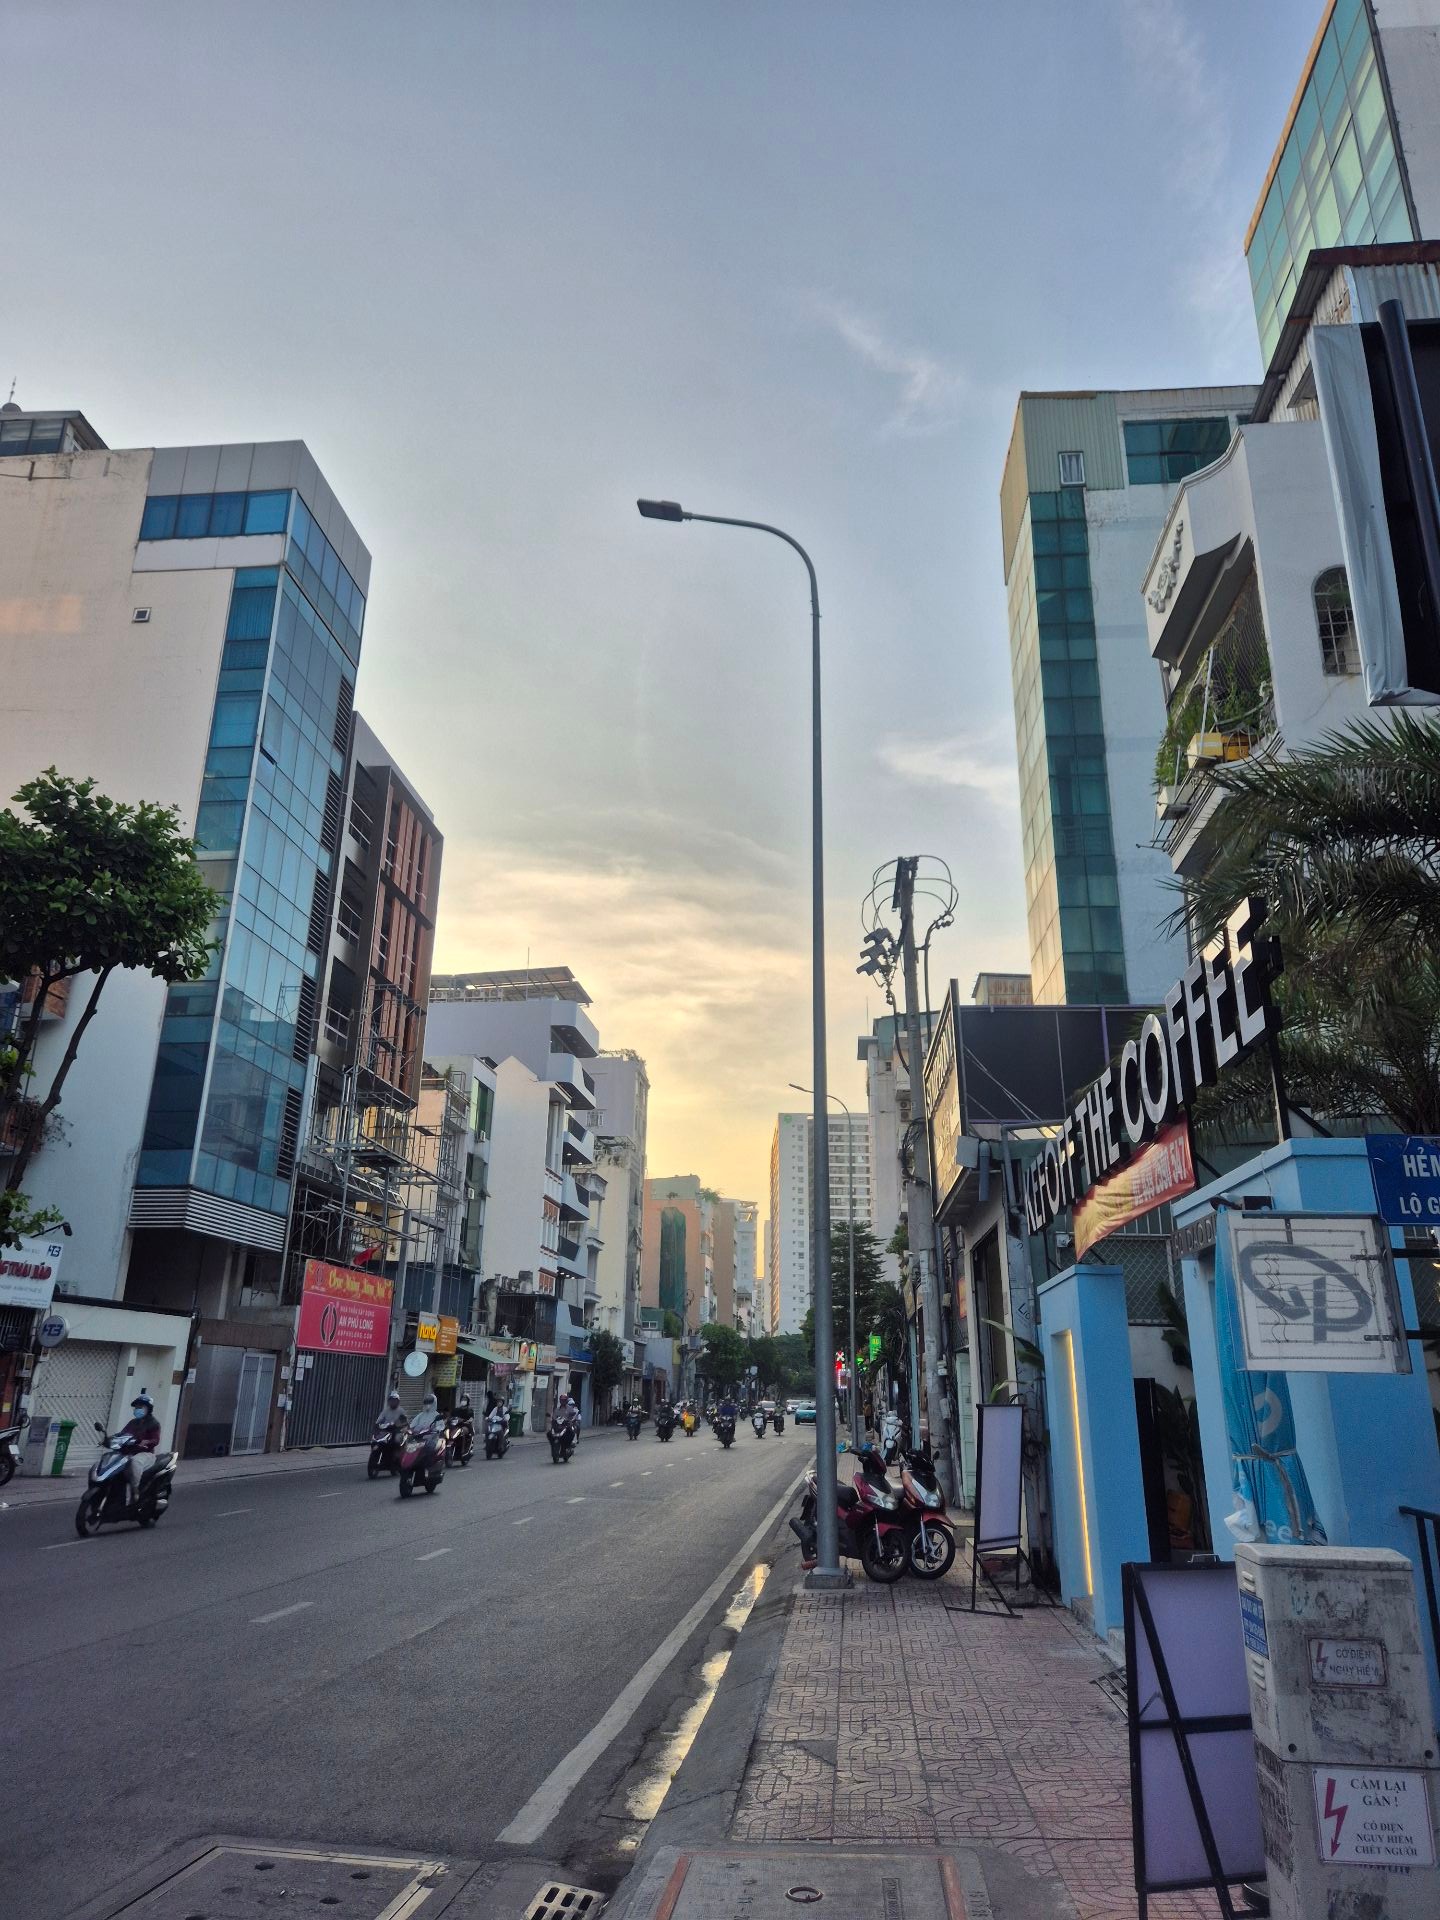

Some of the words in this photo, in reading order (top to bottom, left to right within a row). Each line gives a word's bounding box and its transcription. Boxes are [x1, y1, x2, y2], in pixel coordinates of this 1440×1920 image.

[1074, 1066, 1121, 1185] THE
[1120, 897, 1266, 1143] COFFEE
[1399, 1192, 1423, 1218] LỘ
[359, 1319, 374, 1330] LONG
[1384, 1779, 1407, 1794] LẠI
[1356, 1833, 1384, 1843] NGUY
